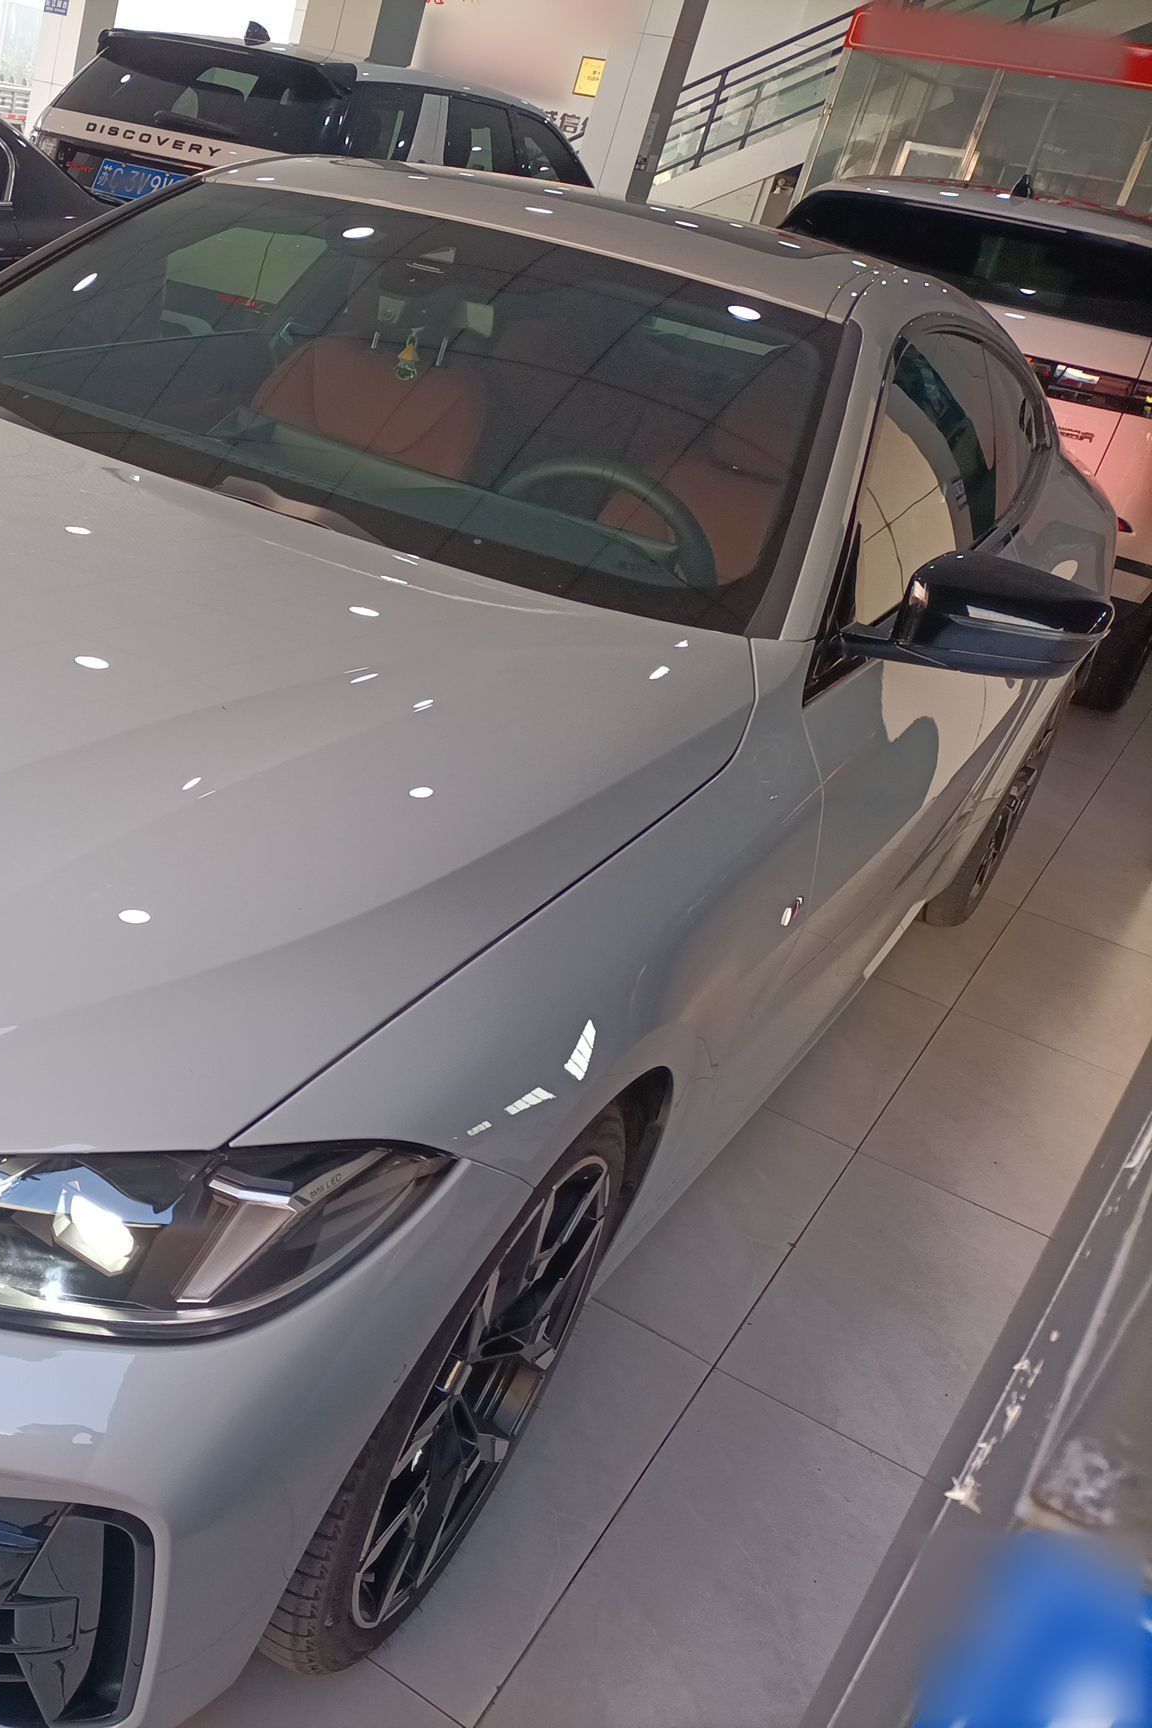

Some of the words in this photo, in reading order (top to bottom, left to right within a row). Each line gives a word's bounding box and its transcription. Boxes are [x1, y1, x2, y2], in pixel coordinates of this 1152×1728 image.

[86, 122, 221, 157] DISCOVERY
[309, 1185, 326, 1200] BMW
[326, 1173, 342, 1189] LED
